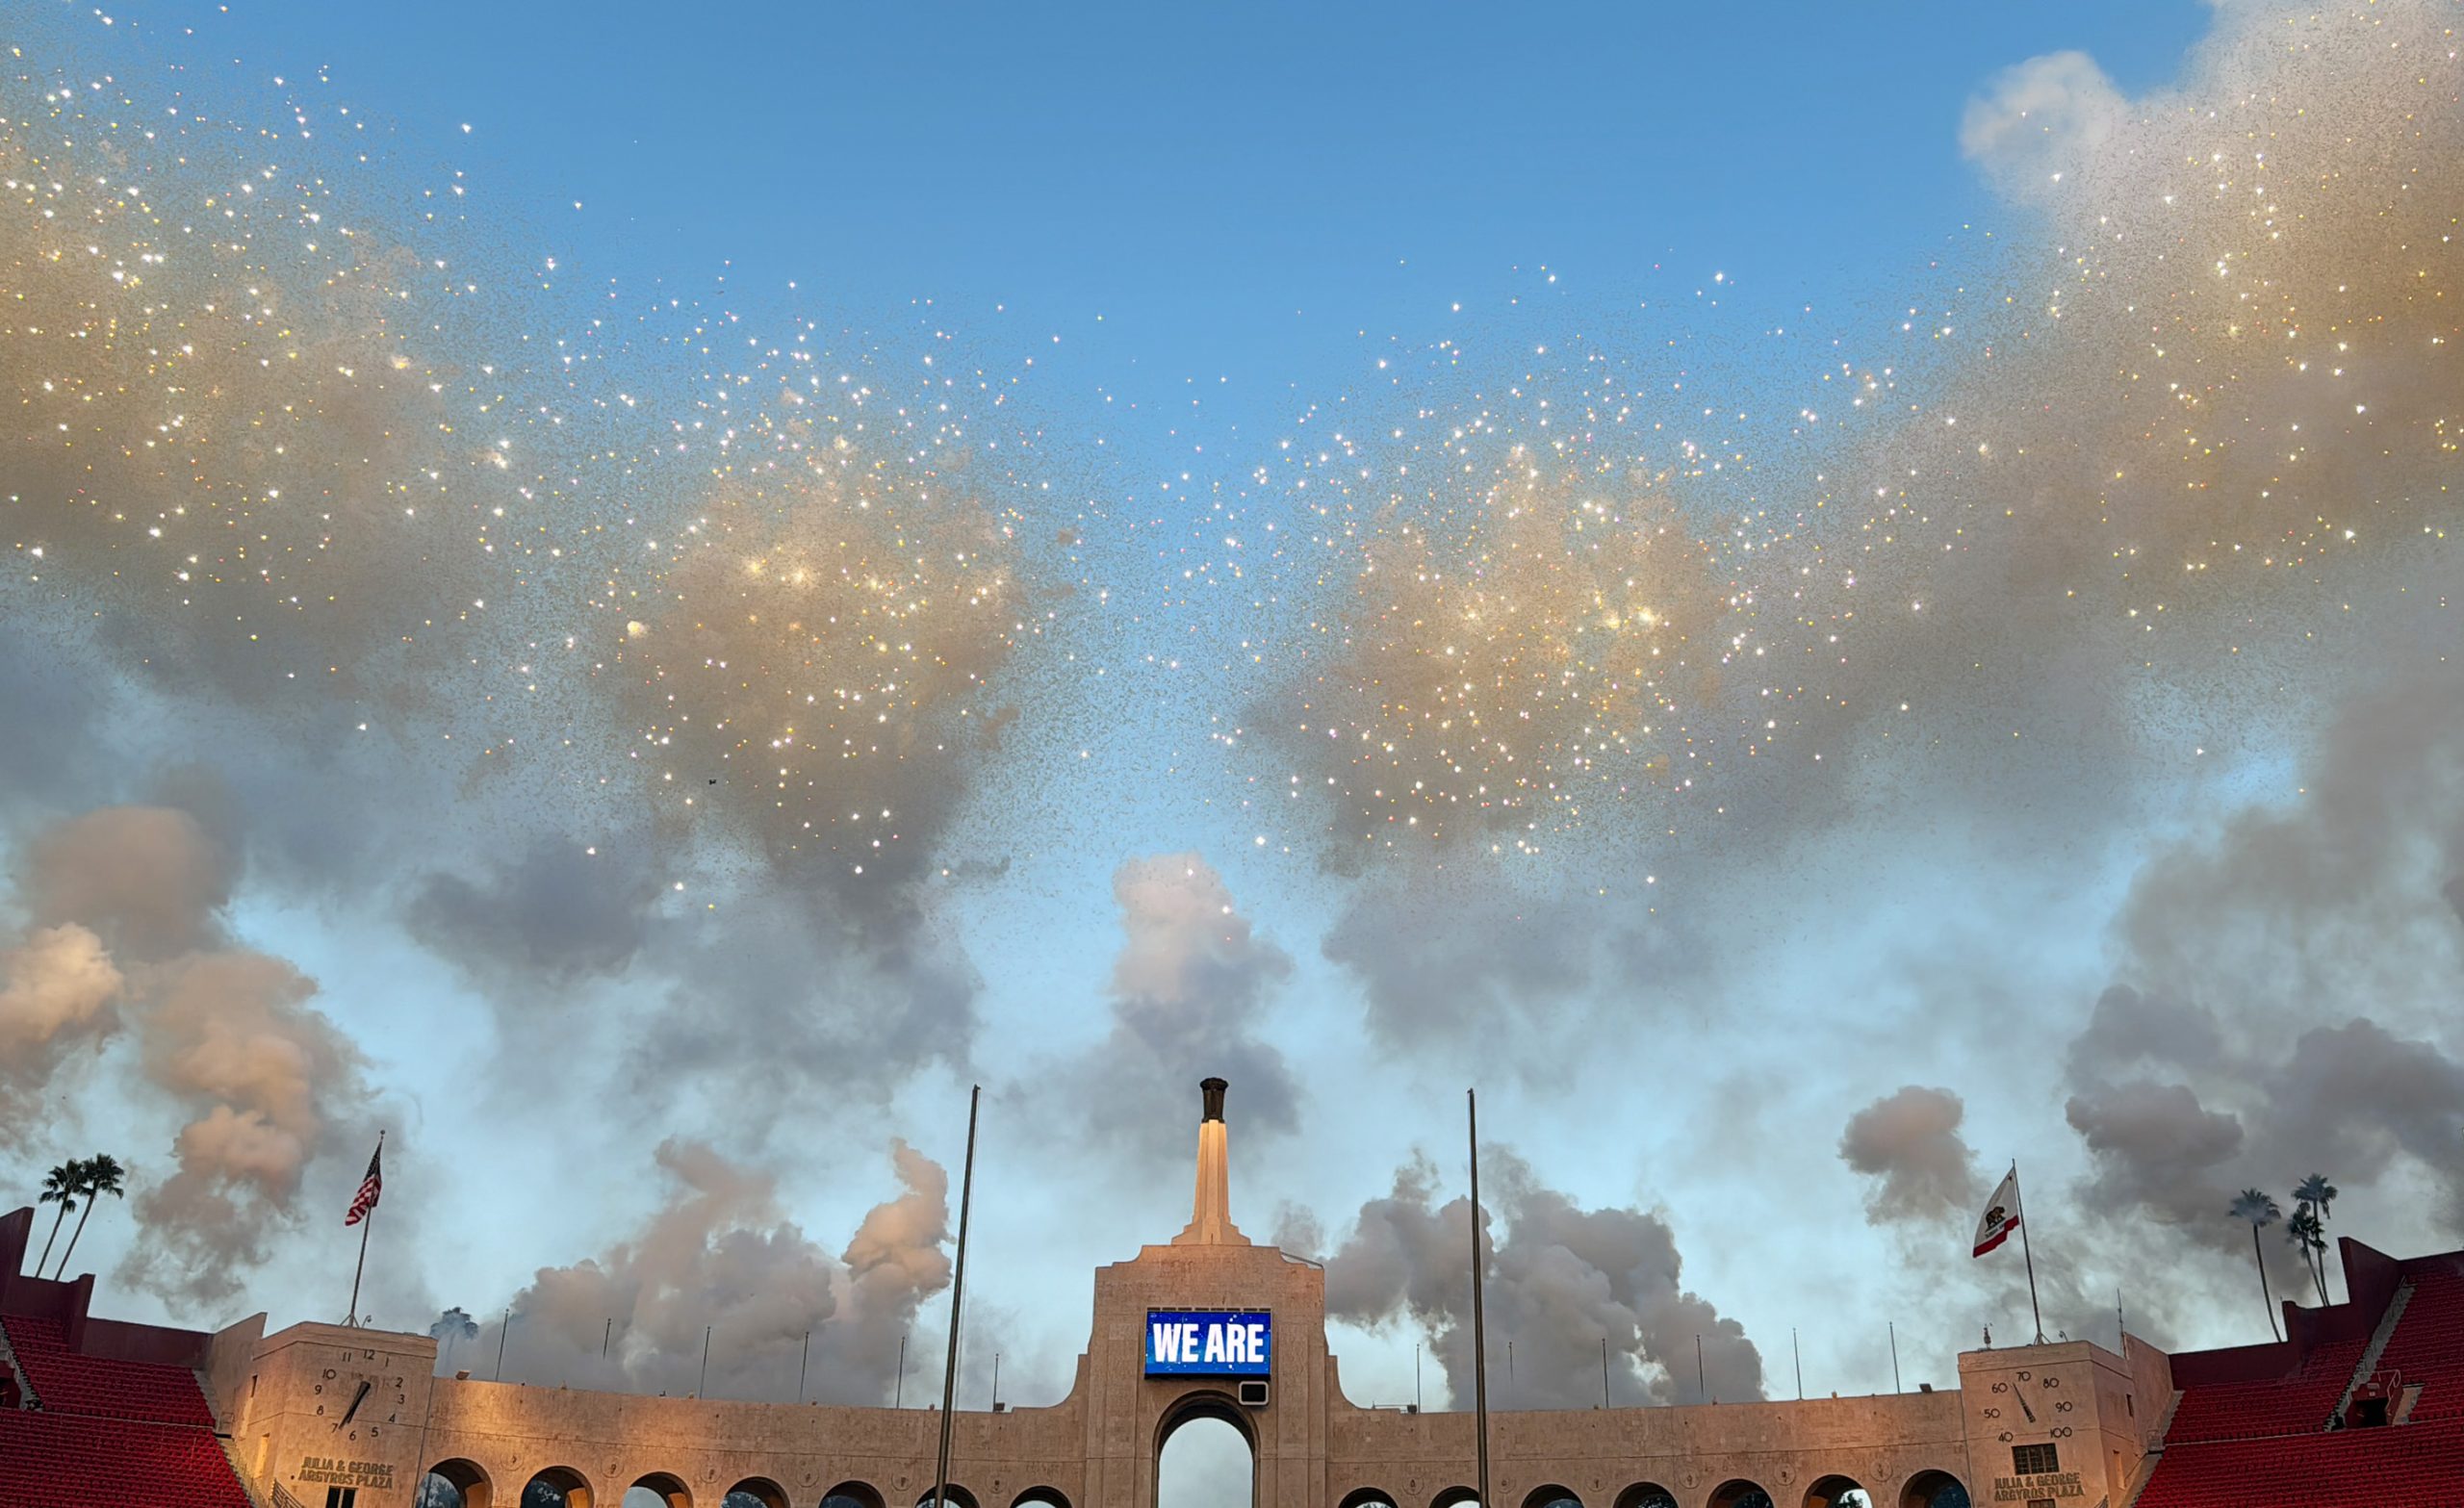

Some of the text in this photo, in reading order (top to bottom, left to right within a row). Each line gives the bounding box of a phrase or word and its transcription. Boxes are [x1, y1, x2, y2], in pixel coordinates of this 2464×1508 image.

[1153, 1323, 1265, 1363] WE ARE
[342, 1352, 351, 1362] 11
[364, 1349, 375, 1360] 12
[385, 1357, 389, 1367] 1
[322, 1368, 336, 1379] 10
[2016, 1371, 2031, 1382] 70
[396, 1376, 403, 1388] 2
[1991, 1382, 2008, 1393] 60
[2042, 1377, 2060, 1389] 80
[315, 1384, 322, 1394] 9
[398, 1394, 404, 1404] 3
[317, 1405, 323, 1416] 8
[2055, 1401, 2072, 1413] 90
[389, 1414, 396, 1422] 4
[1984, 1408, 2000, 1419] 50
[331, 1422, 339, 1433] 7
[371, 1427, 378, 1437] 5
[2049, 1426, 2072, 1438] 100
[348, 1430, 356, 1441] 6
[1998, 1431, 2014, 1443] 40
[301, 1456, 394, 1475] JULIA & GEORGE
[298, 1470, 393, 1489] ARGYROS PLAZA
[1994, 1472, 2081, 1489] JULIA & GEORGE
[1994, 1484, 2085, 1501] ARGYROS PLAZA
